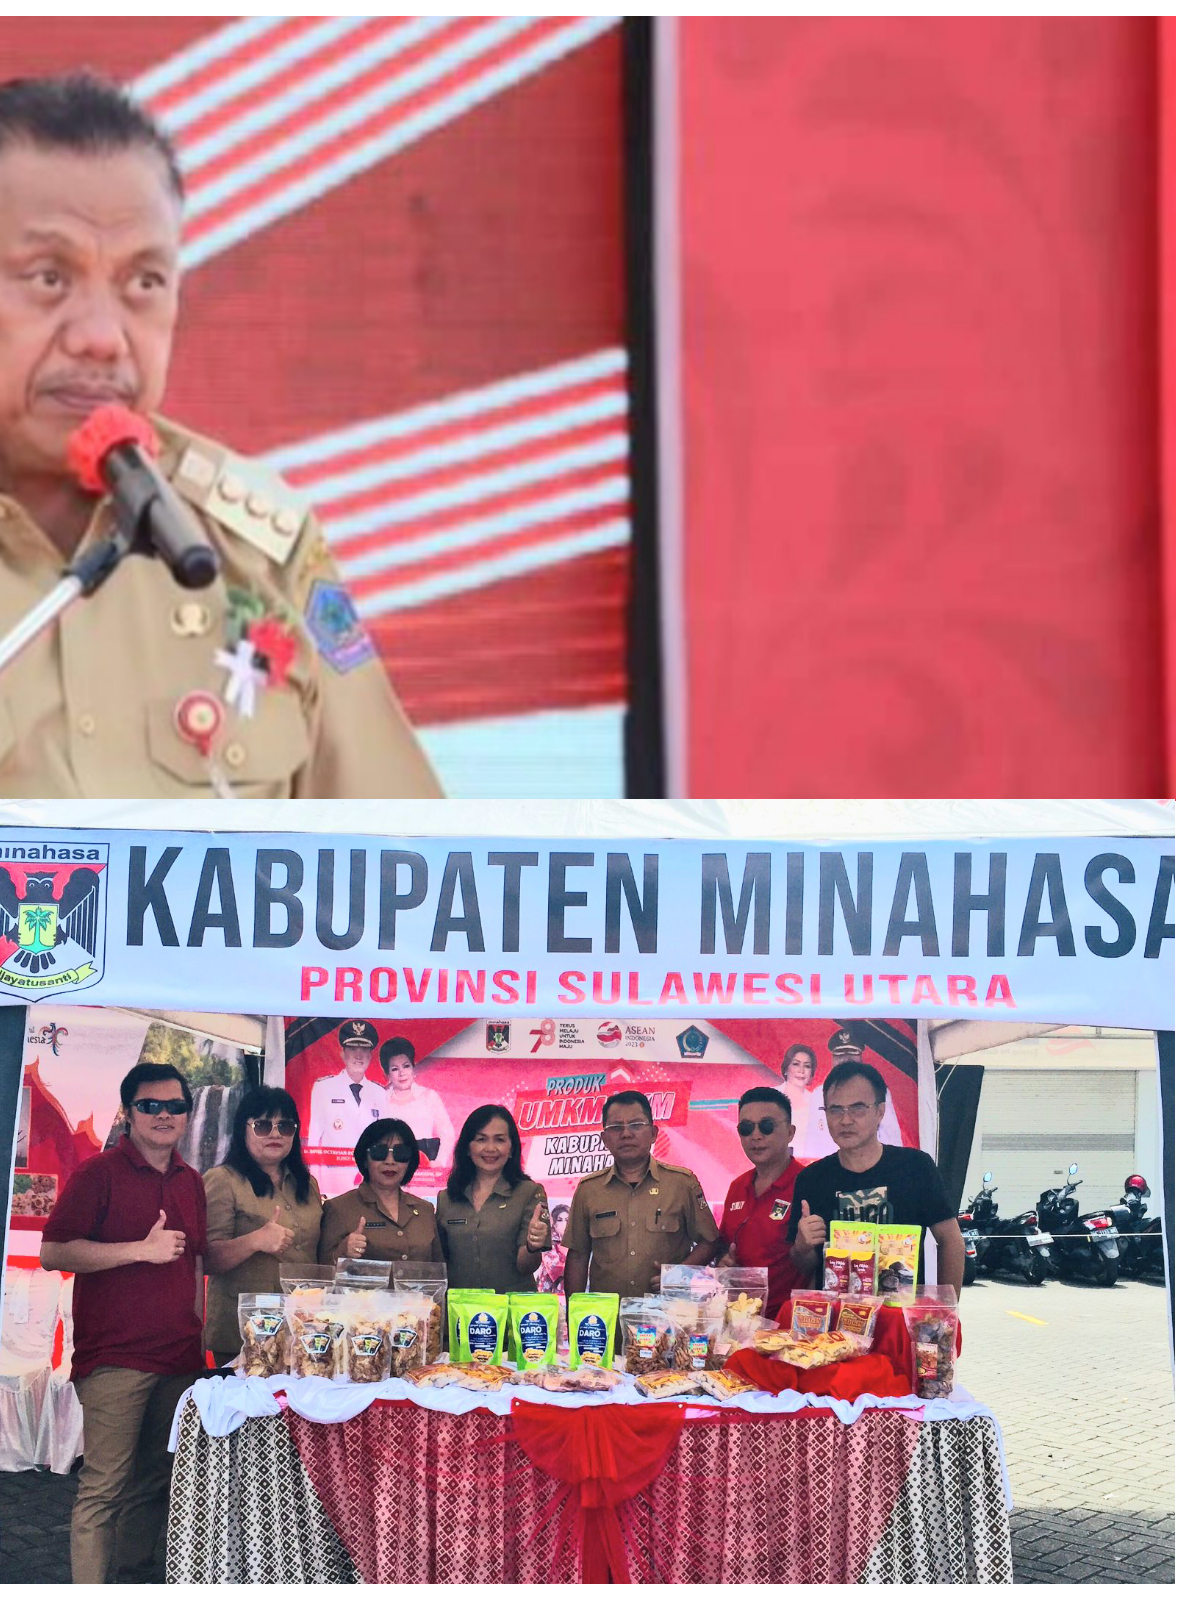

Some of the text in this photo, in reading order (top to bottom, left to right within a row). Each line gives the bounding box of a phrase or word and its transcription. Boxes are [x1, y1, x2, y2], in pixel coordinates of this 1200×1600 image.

[126, 846, 1176, 959] KABUPATEN MINAHASA
[300, 966, 1018, 1009] PROVINSI SULAWESI UTARA
[625, 1026, 656, 1035] ASEAN
[547, 1075, 605, 1096] PRODUK
[518, 1096, 608, 1131] UMKM
